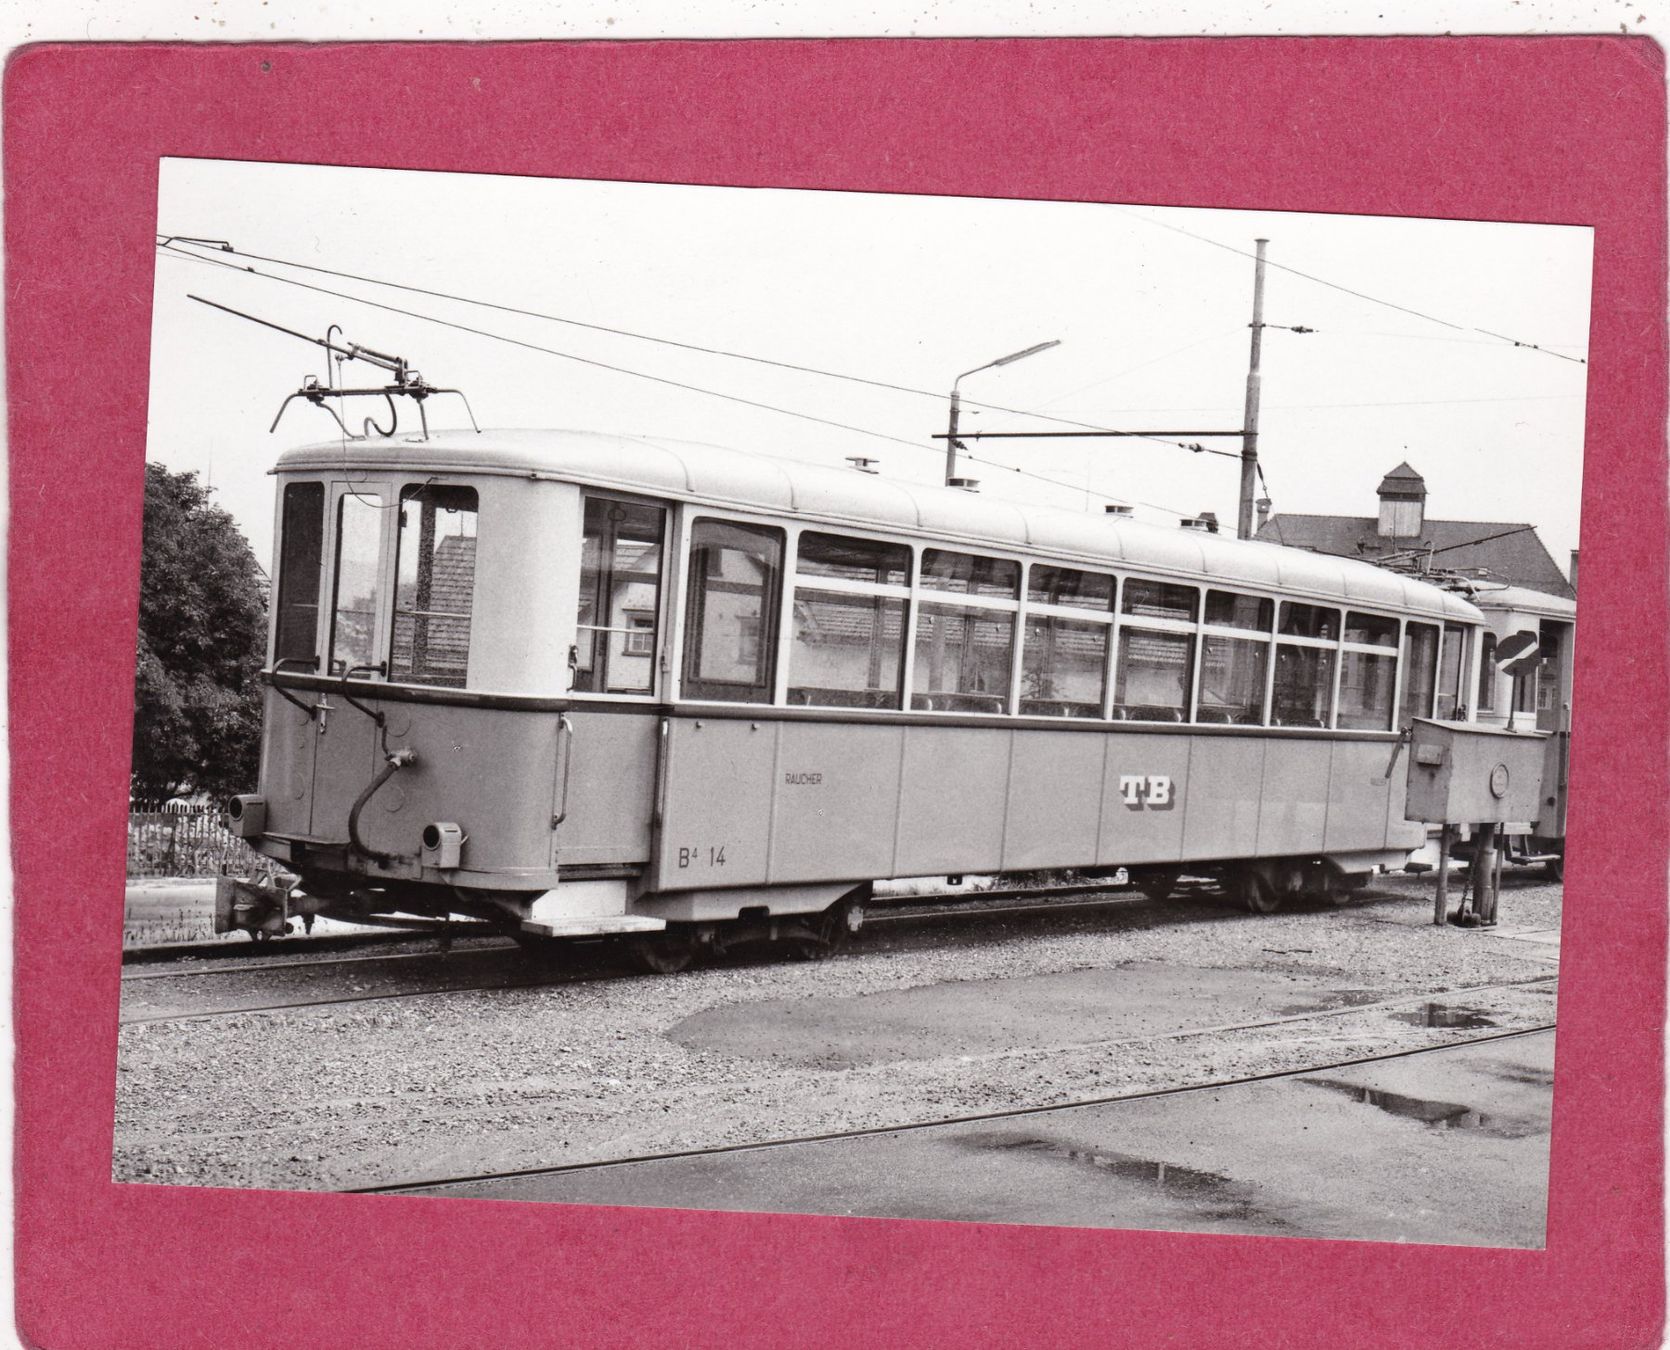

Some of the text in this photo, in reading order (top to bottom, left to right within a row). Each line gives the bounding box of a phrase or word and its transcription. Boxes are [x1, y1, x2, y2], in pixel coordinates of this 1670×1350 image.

[785, 773, 822, 784] RAUCHER
[1120, 775, 1174, 811] TB
[710, 846, 726, 867] 14
